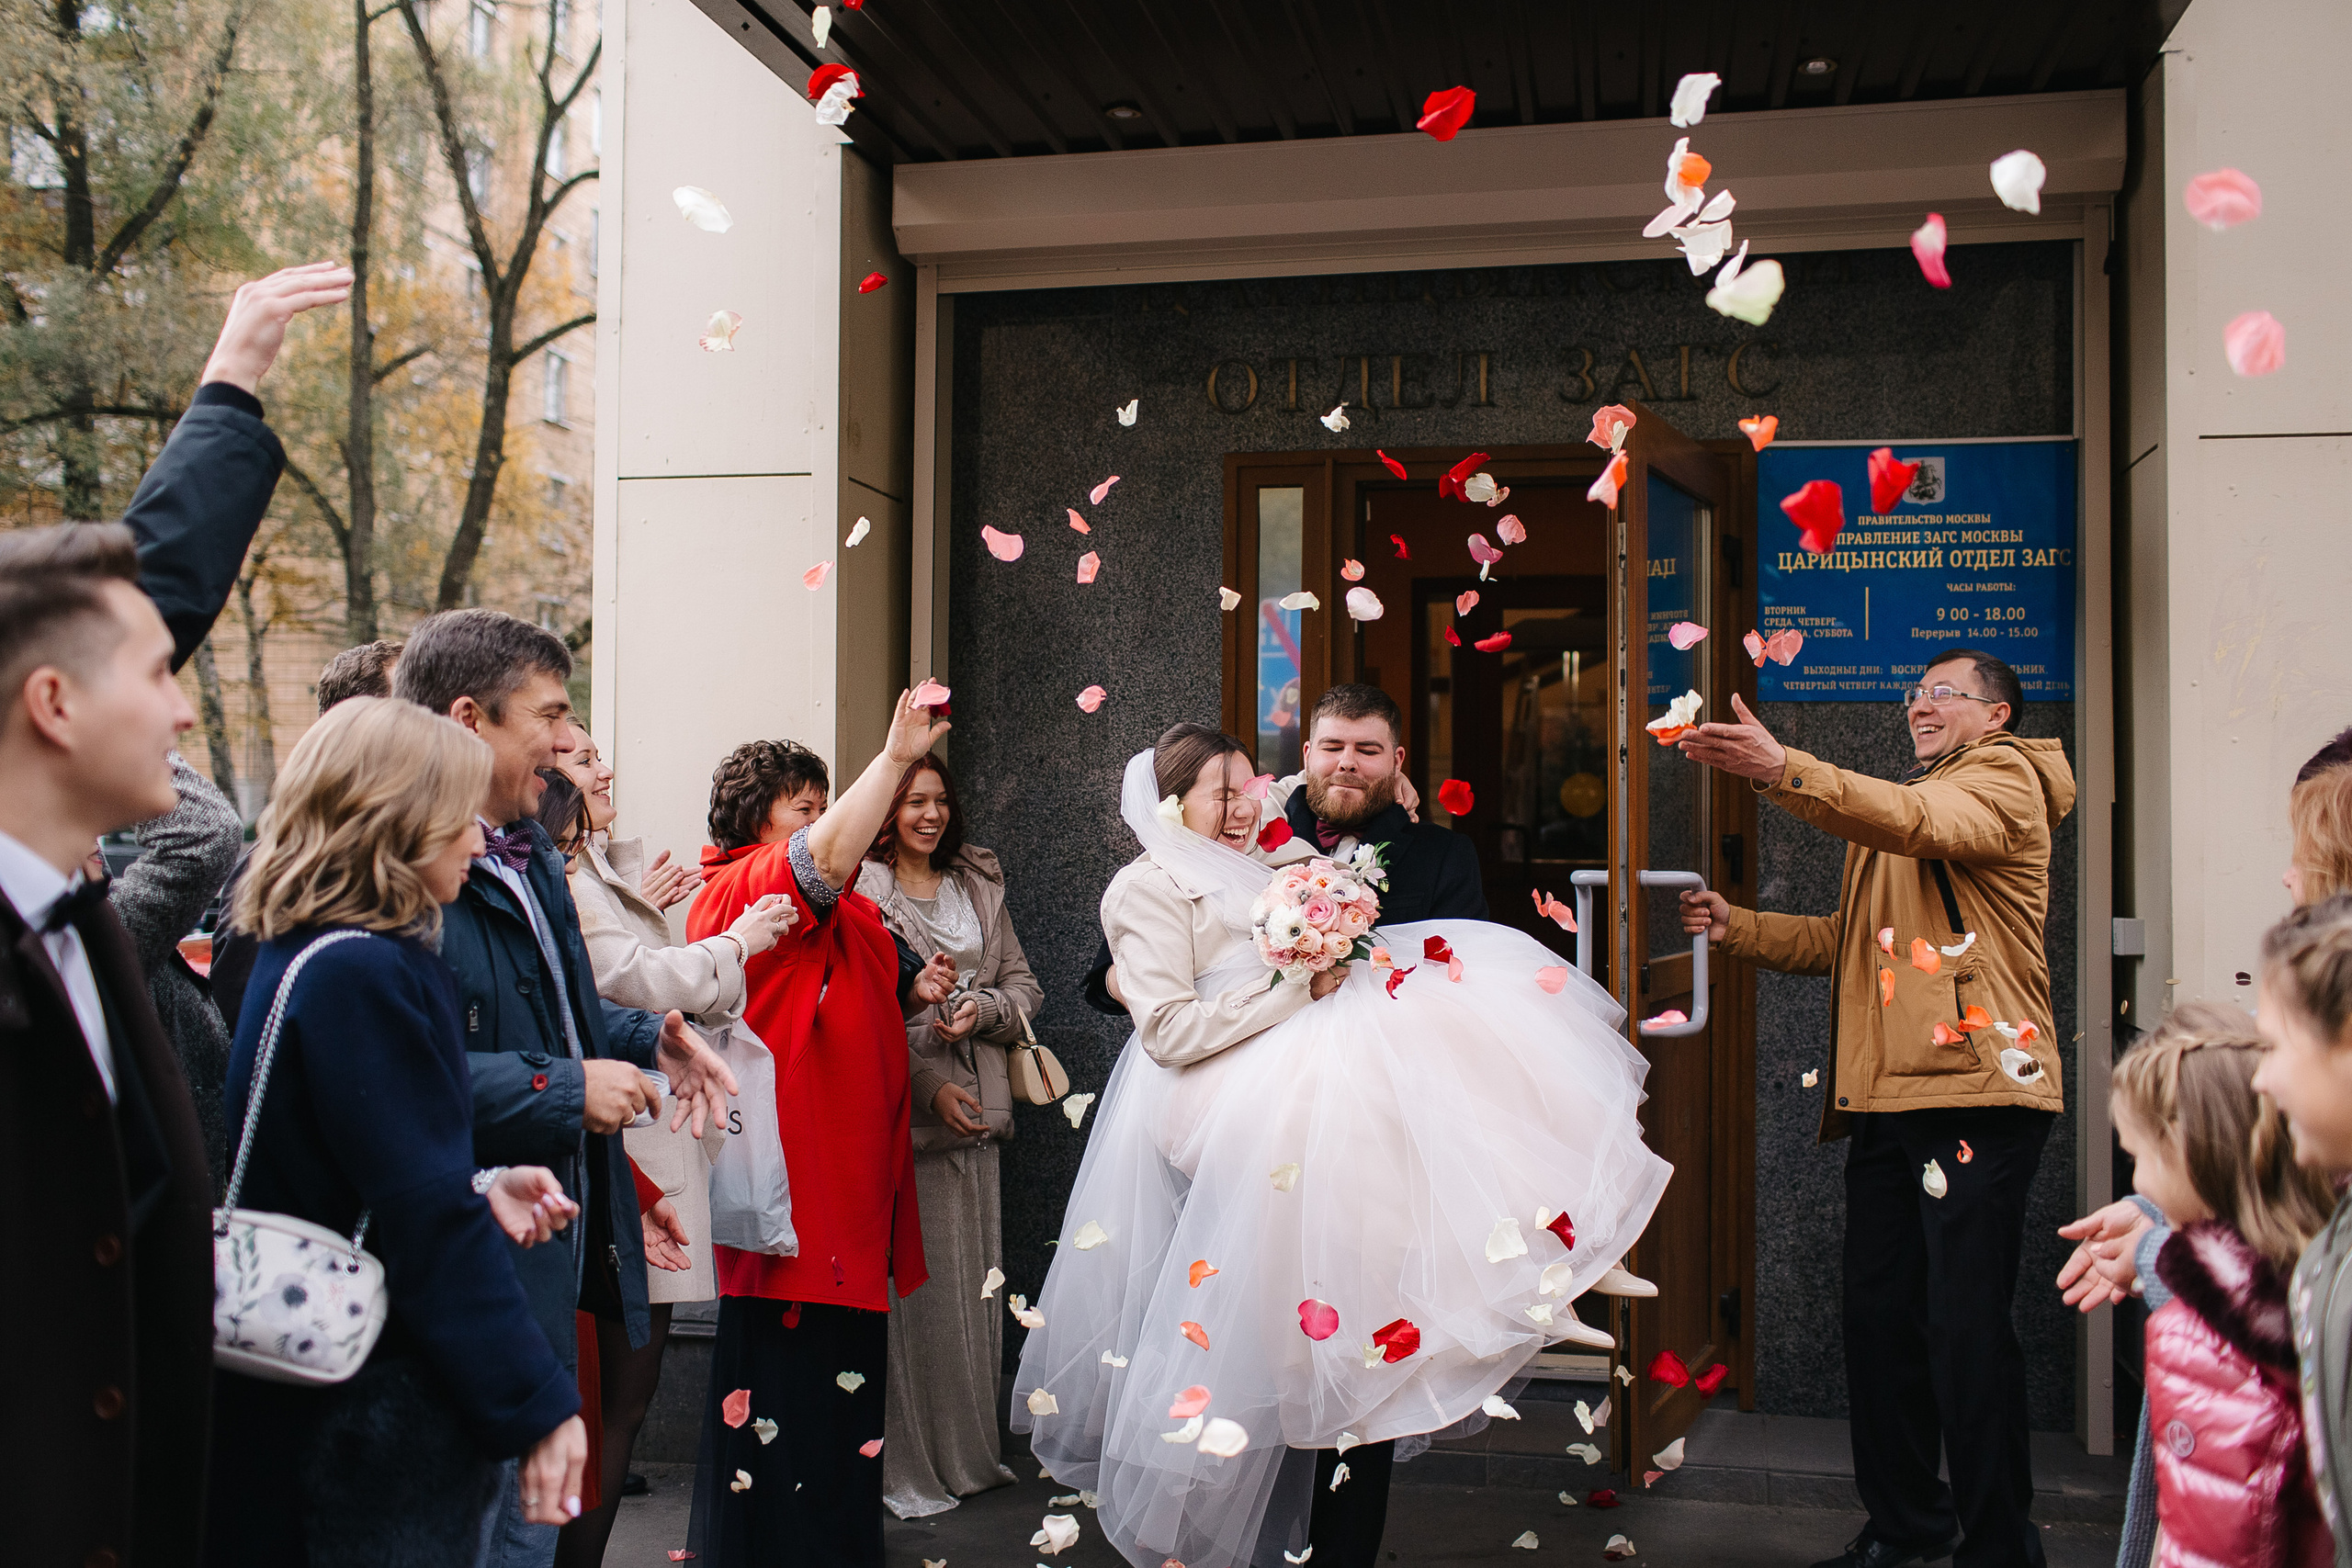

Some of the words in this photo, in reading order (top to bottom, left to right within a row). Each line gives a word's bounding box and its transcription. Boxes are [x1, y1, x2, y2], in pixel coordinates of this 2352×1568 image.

[1206, 350, 1497, 423] ОТДЕЛ
[1558, 339, 1783, 404] ЗАГС
[1858, 514, 1943, 525] ПРАВИТЕЛЬСТВО
[1946, 513, 1991, 525] МОСКВЫ
[1835, 531, 1920, 546] ПРАВЛЕНИЕ
[1924, 531, 1957, 545] ЗАГС
[1961, 530, 2023, 544] МОСКВЫ
[1778, 547, 1943, 573] ЦАРИЦЫНСКИЙ
[1950, 548, 2016, 571] ОТДЕЛ
[2022, 548, 2071, 567] ЗАГС
[1946, 582, 1973, 592] ЧАСЫ
[1975, 582, 2017, 592] РАБОТЫ:
[1764, 606, 1806, 615] ВТОРНИК
[1984, 607, 2026, 621] 18.00
[1764, 617, 1795, 627] СРЕДА,
[1814, 628, 1853, 637] СУББОТА
[1911, 627, 1961, 640] Перерыв
[1968, 627, 1997, 637] 14.00
[2008, 627, 2039, 637] 15.00
[1804, 666, 1857, 675] ВЫХОДНЫЕ
[1860, 666, 1883, 675] ДНИ:
[1783, 681, 1837, 690] ЧЕТВЕРТЫЙ
[1839, 682, 1877, 690] ЧЕТВЕРГ
